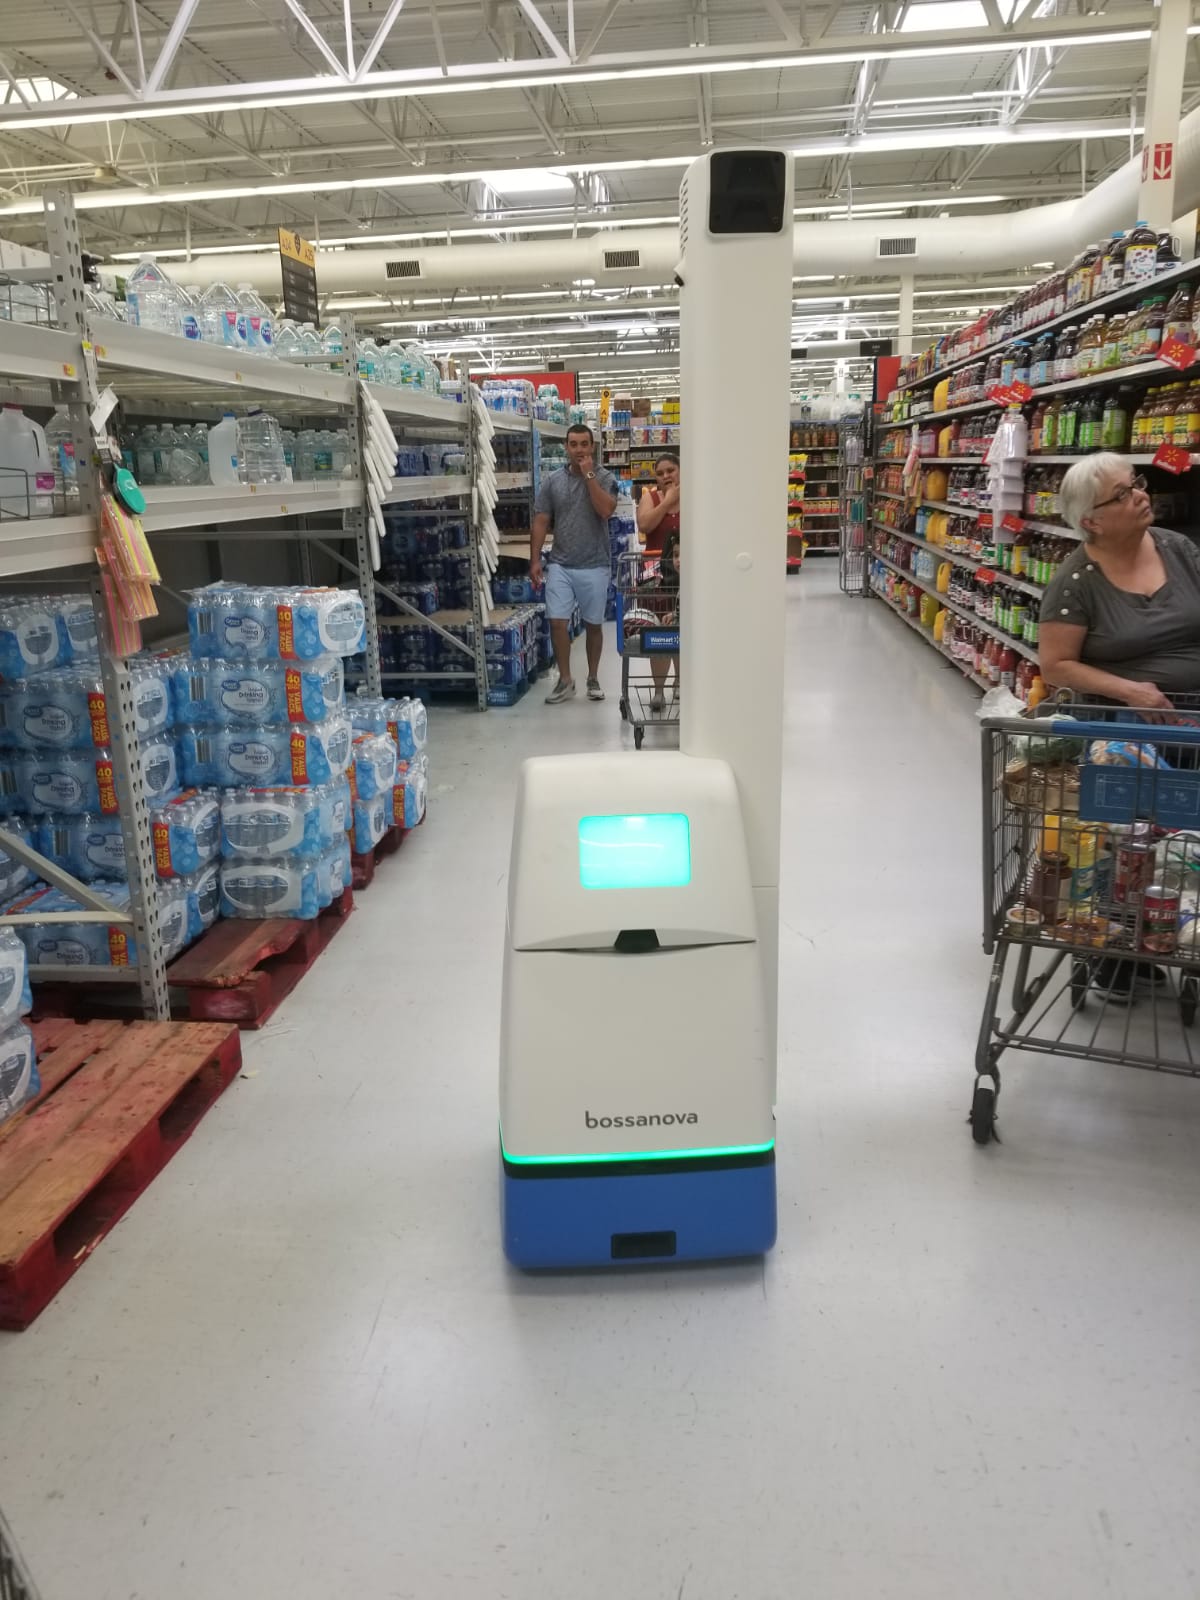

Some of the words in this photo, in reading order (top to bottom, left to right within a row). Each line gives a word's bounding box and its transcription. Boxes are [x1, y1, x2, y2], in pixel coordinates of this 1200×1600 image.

[278, 610, 292, 621] 40
[286, 674, 301, 685] 40
[89, 700, 105, 710] 40
[291, 739, 305, 748] 40
[97, 767, 112, 777] 40
[154, 829, 168, 838] 40
[110, 933, 126, 944] 40
[585, 1110, 699, 1129] bossanova
